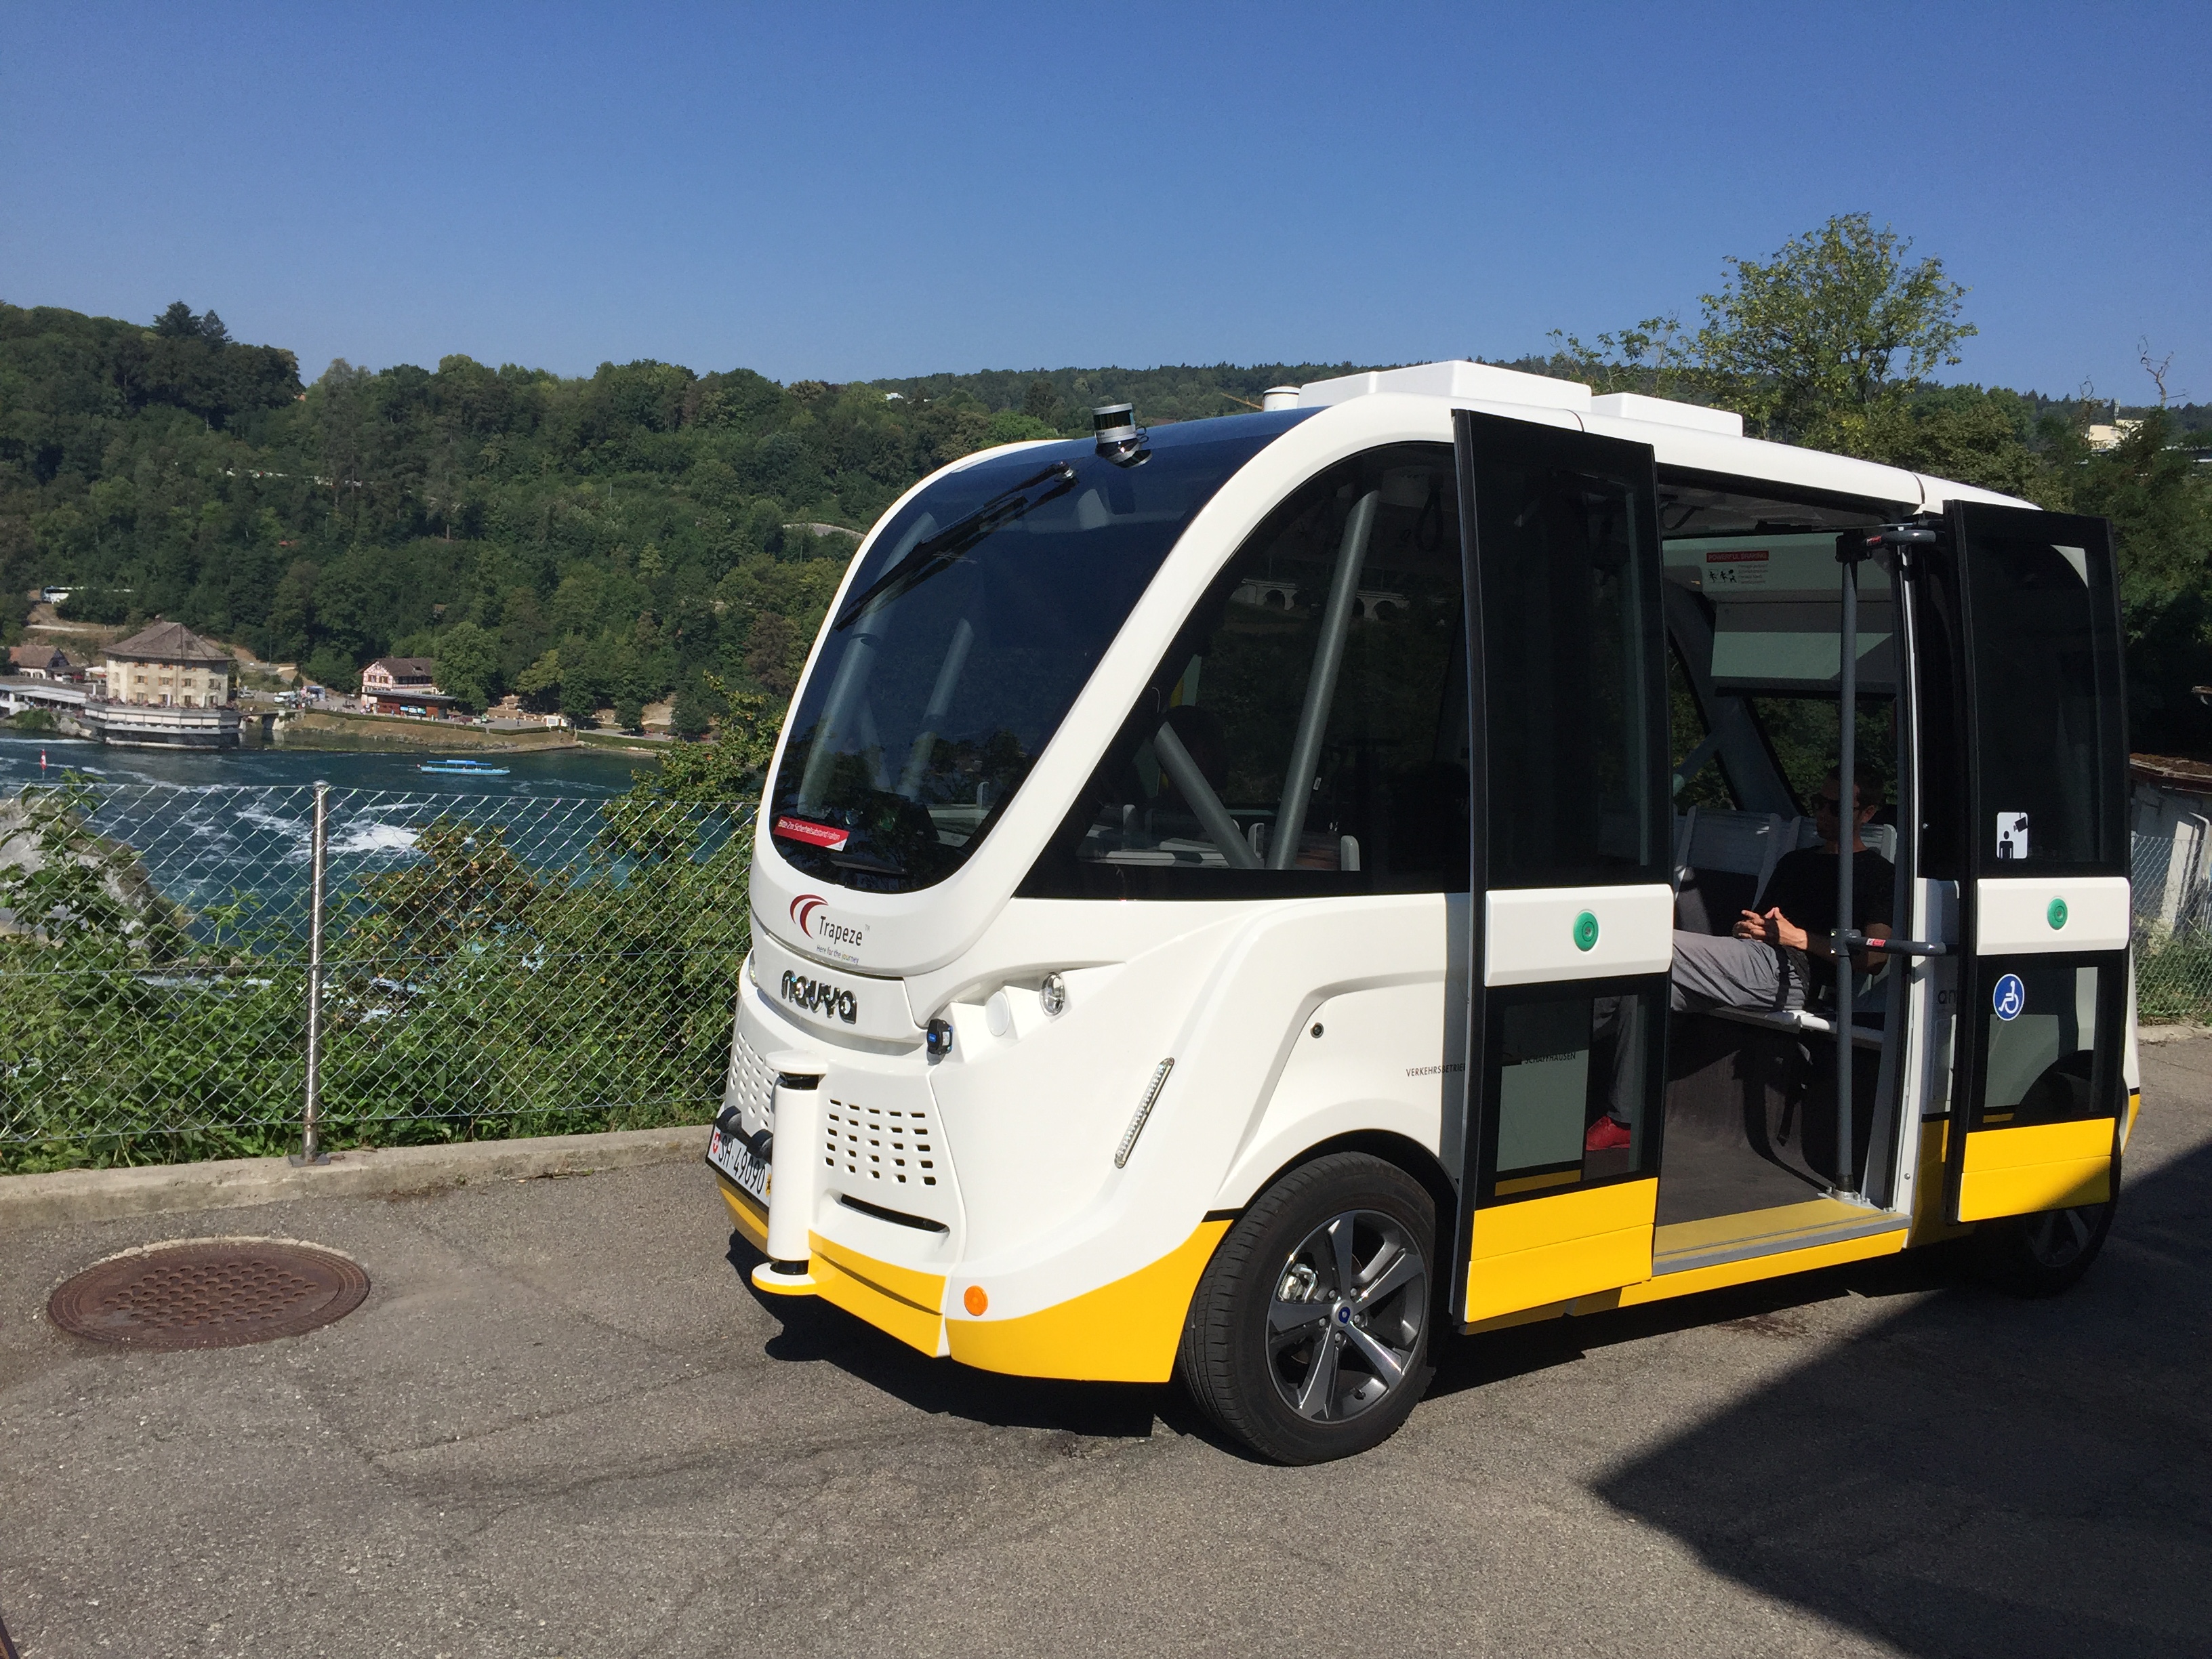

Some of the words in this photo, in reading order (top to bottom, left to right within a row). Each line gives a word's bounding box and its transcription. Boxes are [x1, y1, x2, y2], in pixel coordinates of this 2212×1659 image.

[819, 915, 863, 947] Trapeze
[816, 944, 827, 954] Here
[834, 948, 842, 959] the
[841, 951, 860, 966] journey
